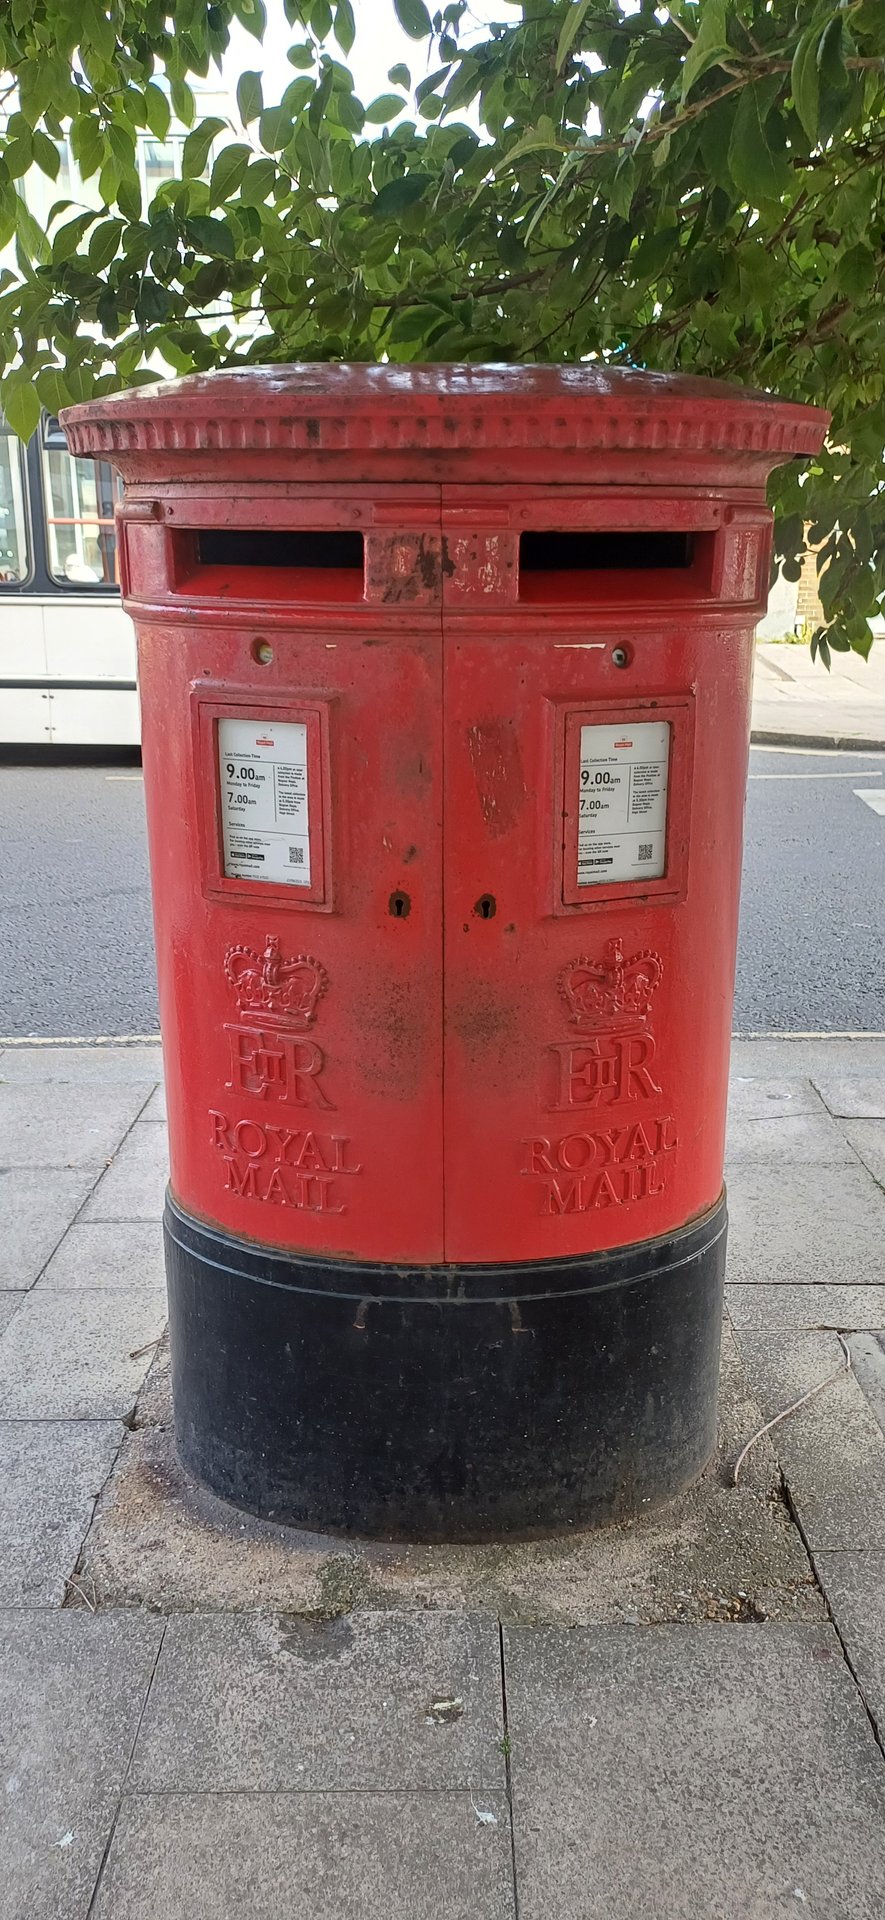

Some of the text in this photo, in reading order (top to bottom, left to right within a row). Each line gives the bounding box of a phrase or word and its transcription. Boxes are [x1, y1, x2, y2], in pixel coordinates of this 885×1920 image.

[226, 763, 266, 781] 9.00am
[227, 792, 256, 805] 7.00am
[581, 770, 620, 785] 9.00am
[209, 1109, 363, 1176] ROYAL
[520, 1115, 679, 1178] ROYAL
[223, 1155, 348, 1216] MAIL
[539, 1160, 668, 1216] MAIL
